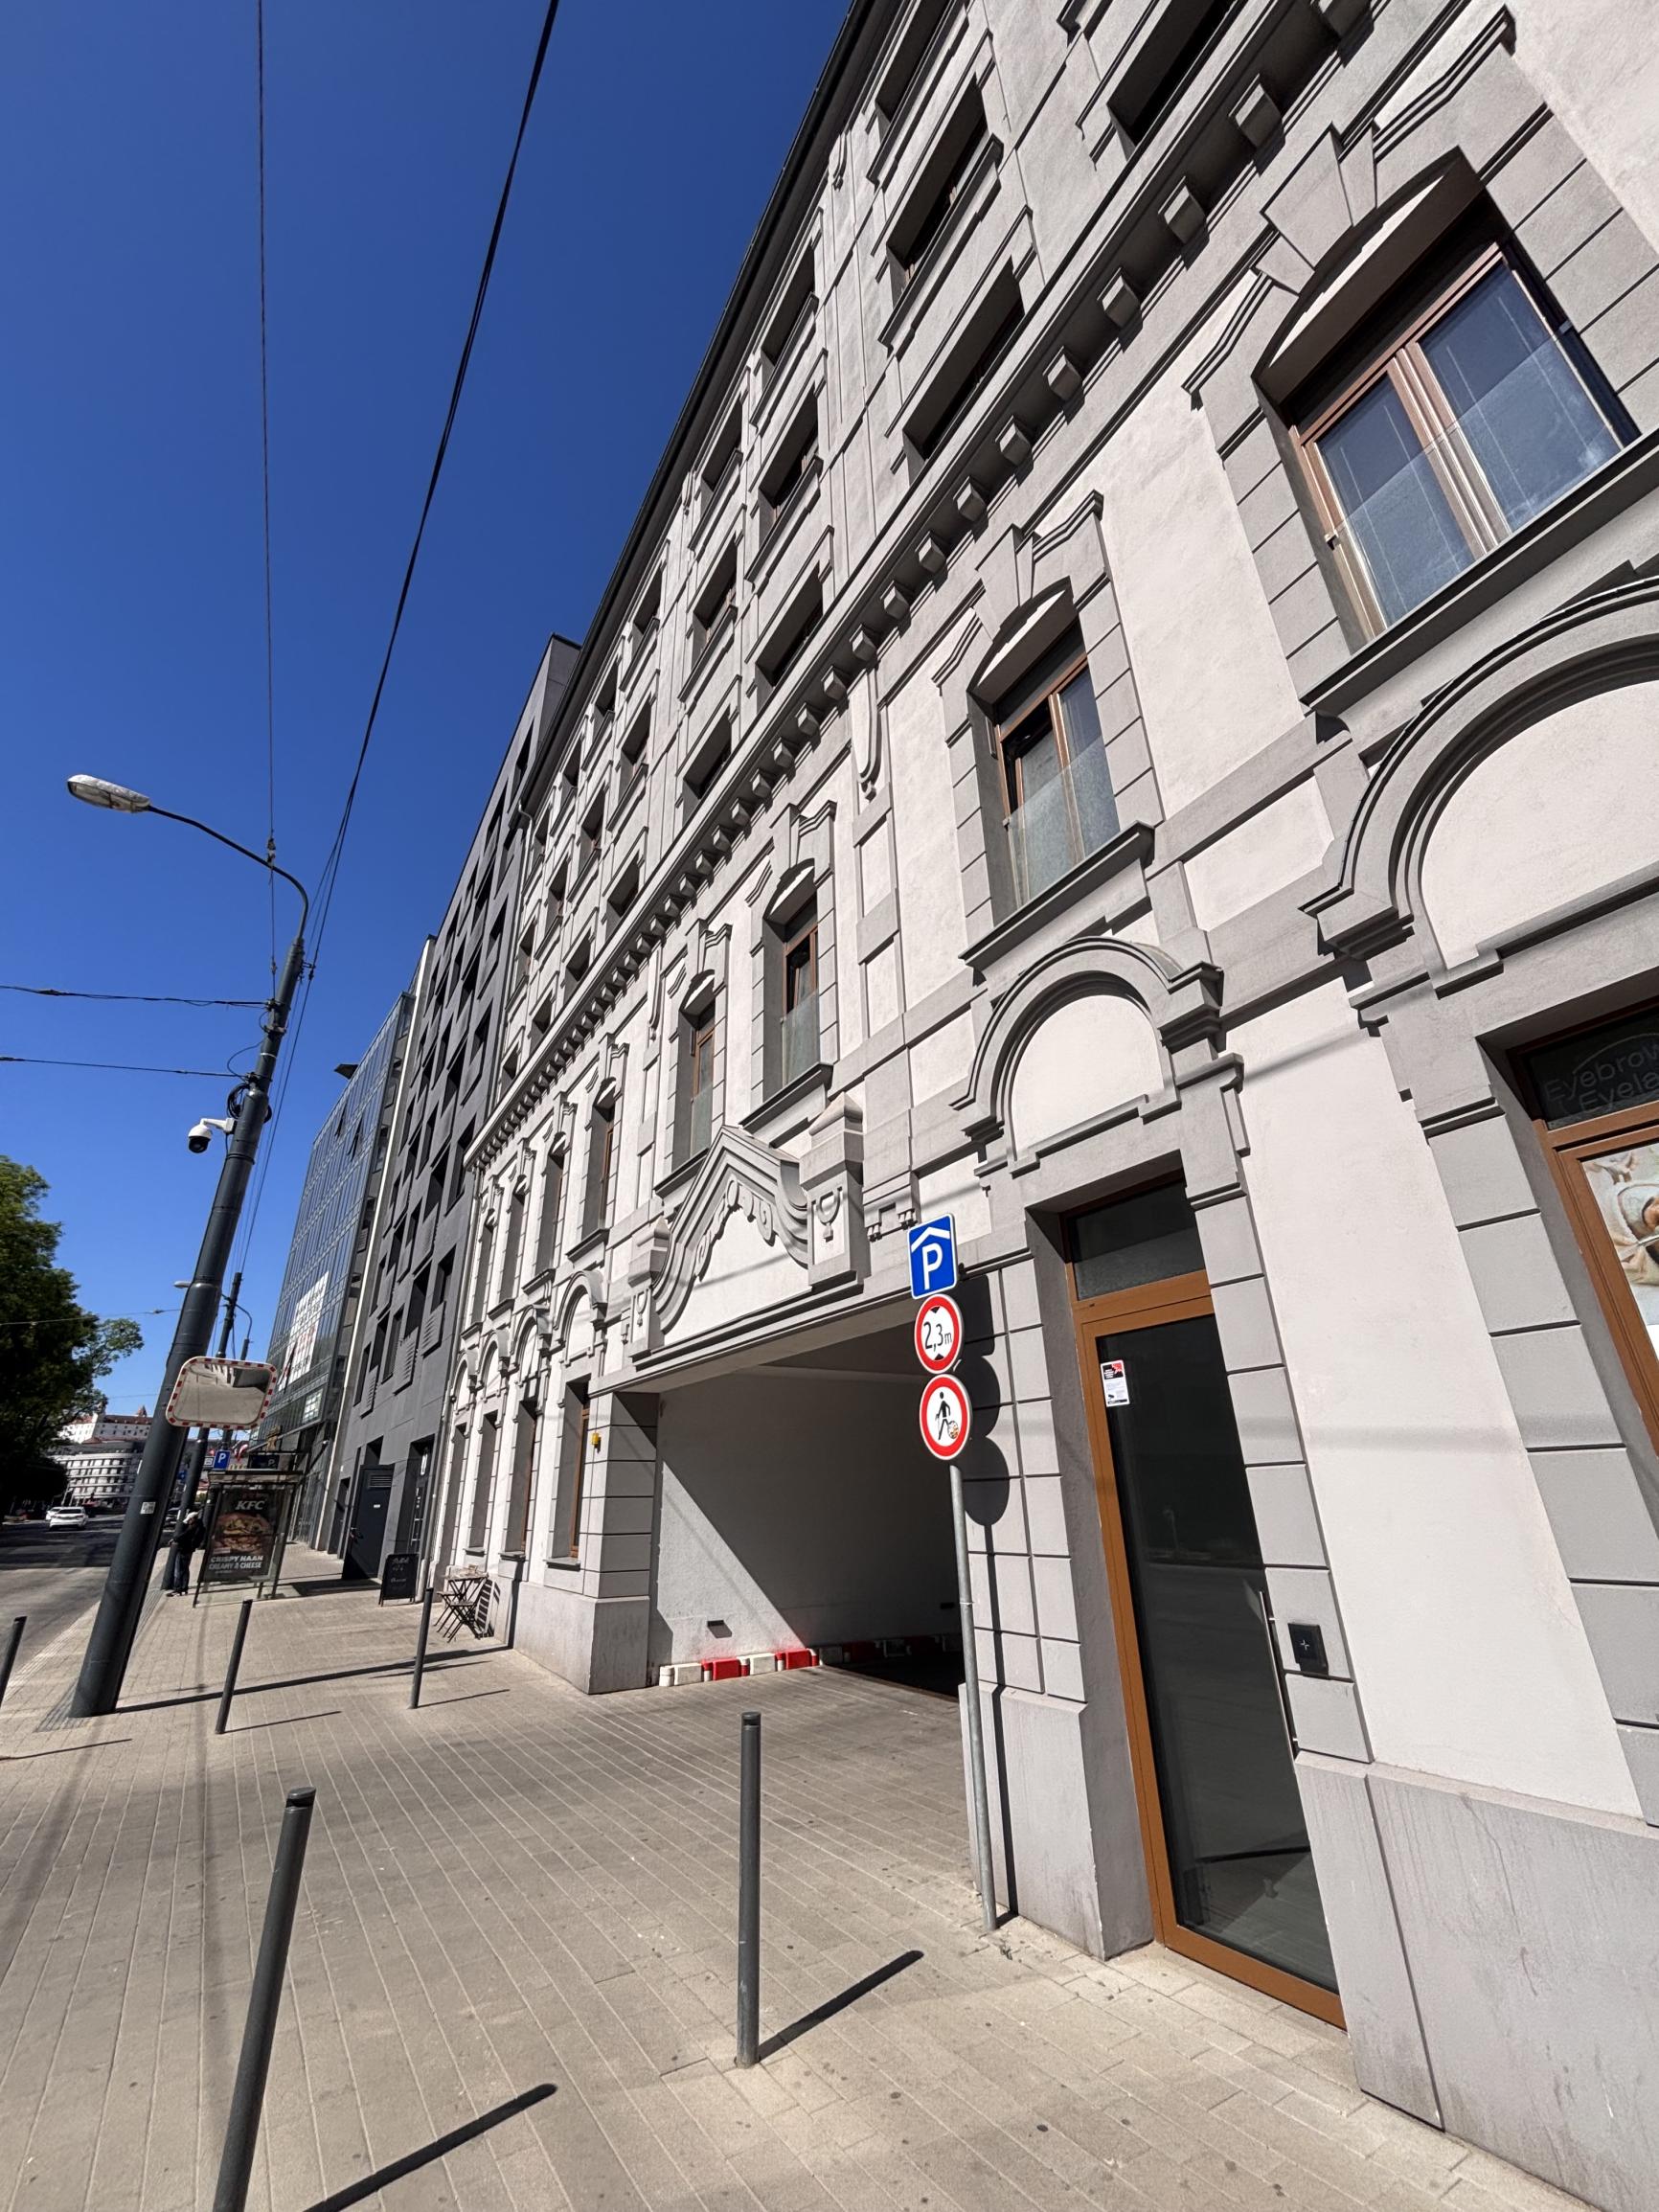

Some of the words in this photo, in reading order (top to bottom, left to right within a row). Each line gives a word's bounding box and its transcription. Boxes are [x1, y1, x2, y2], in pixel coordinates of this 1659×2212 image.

[921, 1243, 943, 1289] P
[217, 1452, 227, 1464] P
[235, 1500, 265, 1511] KFC
